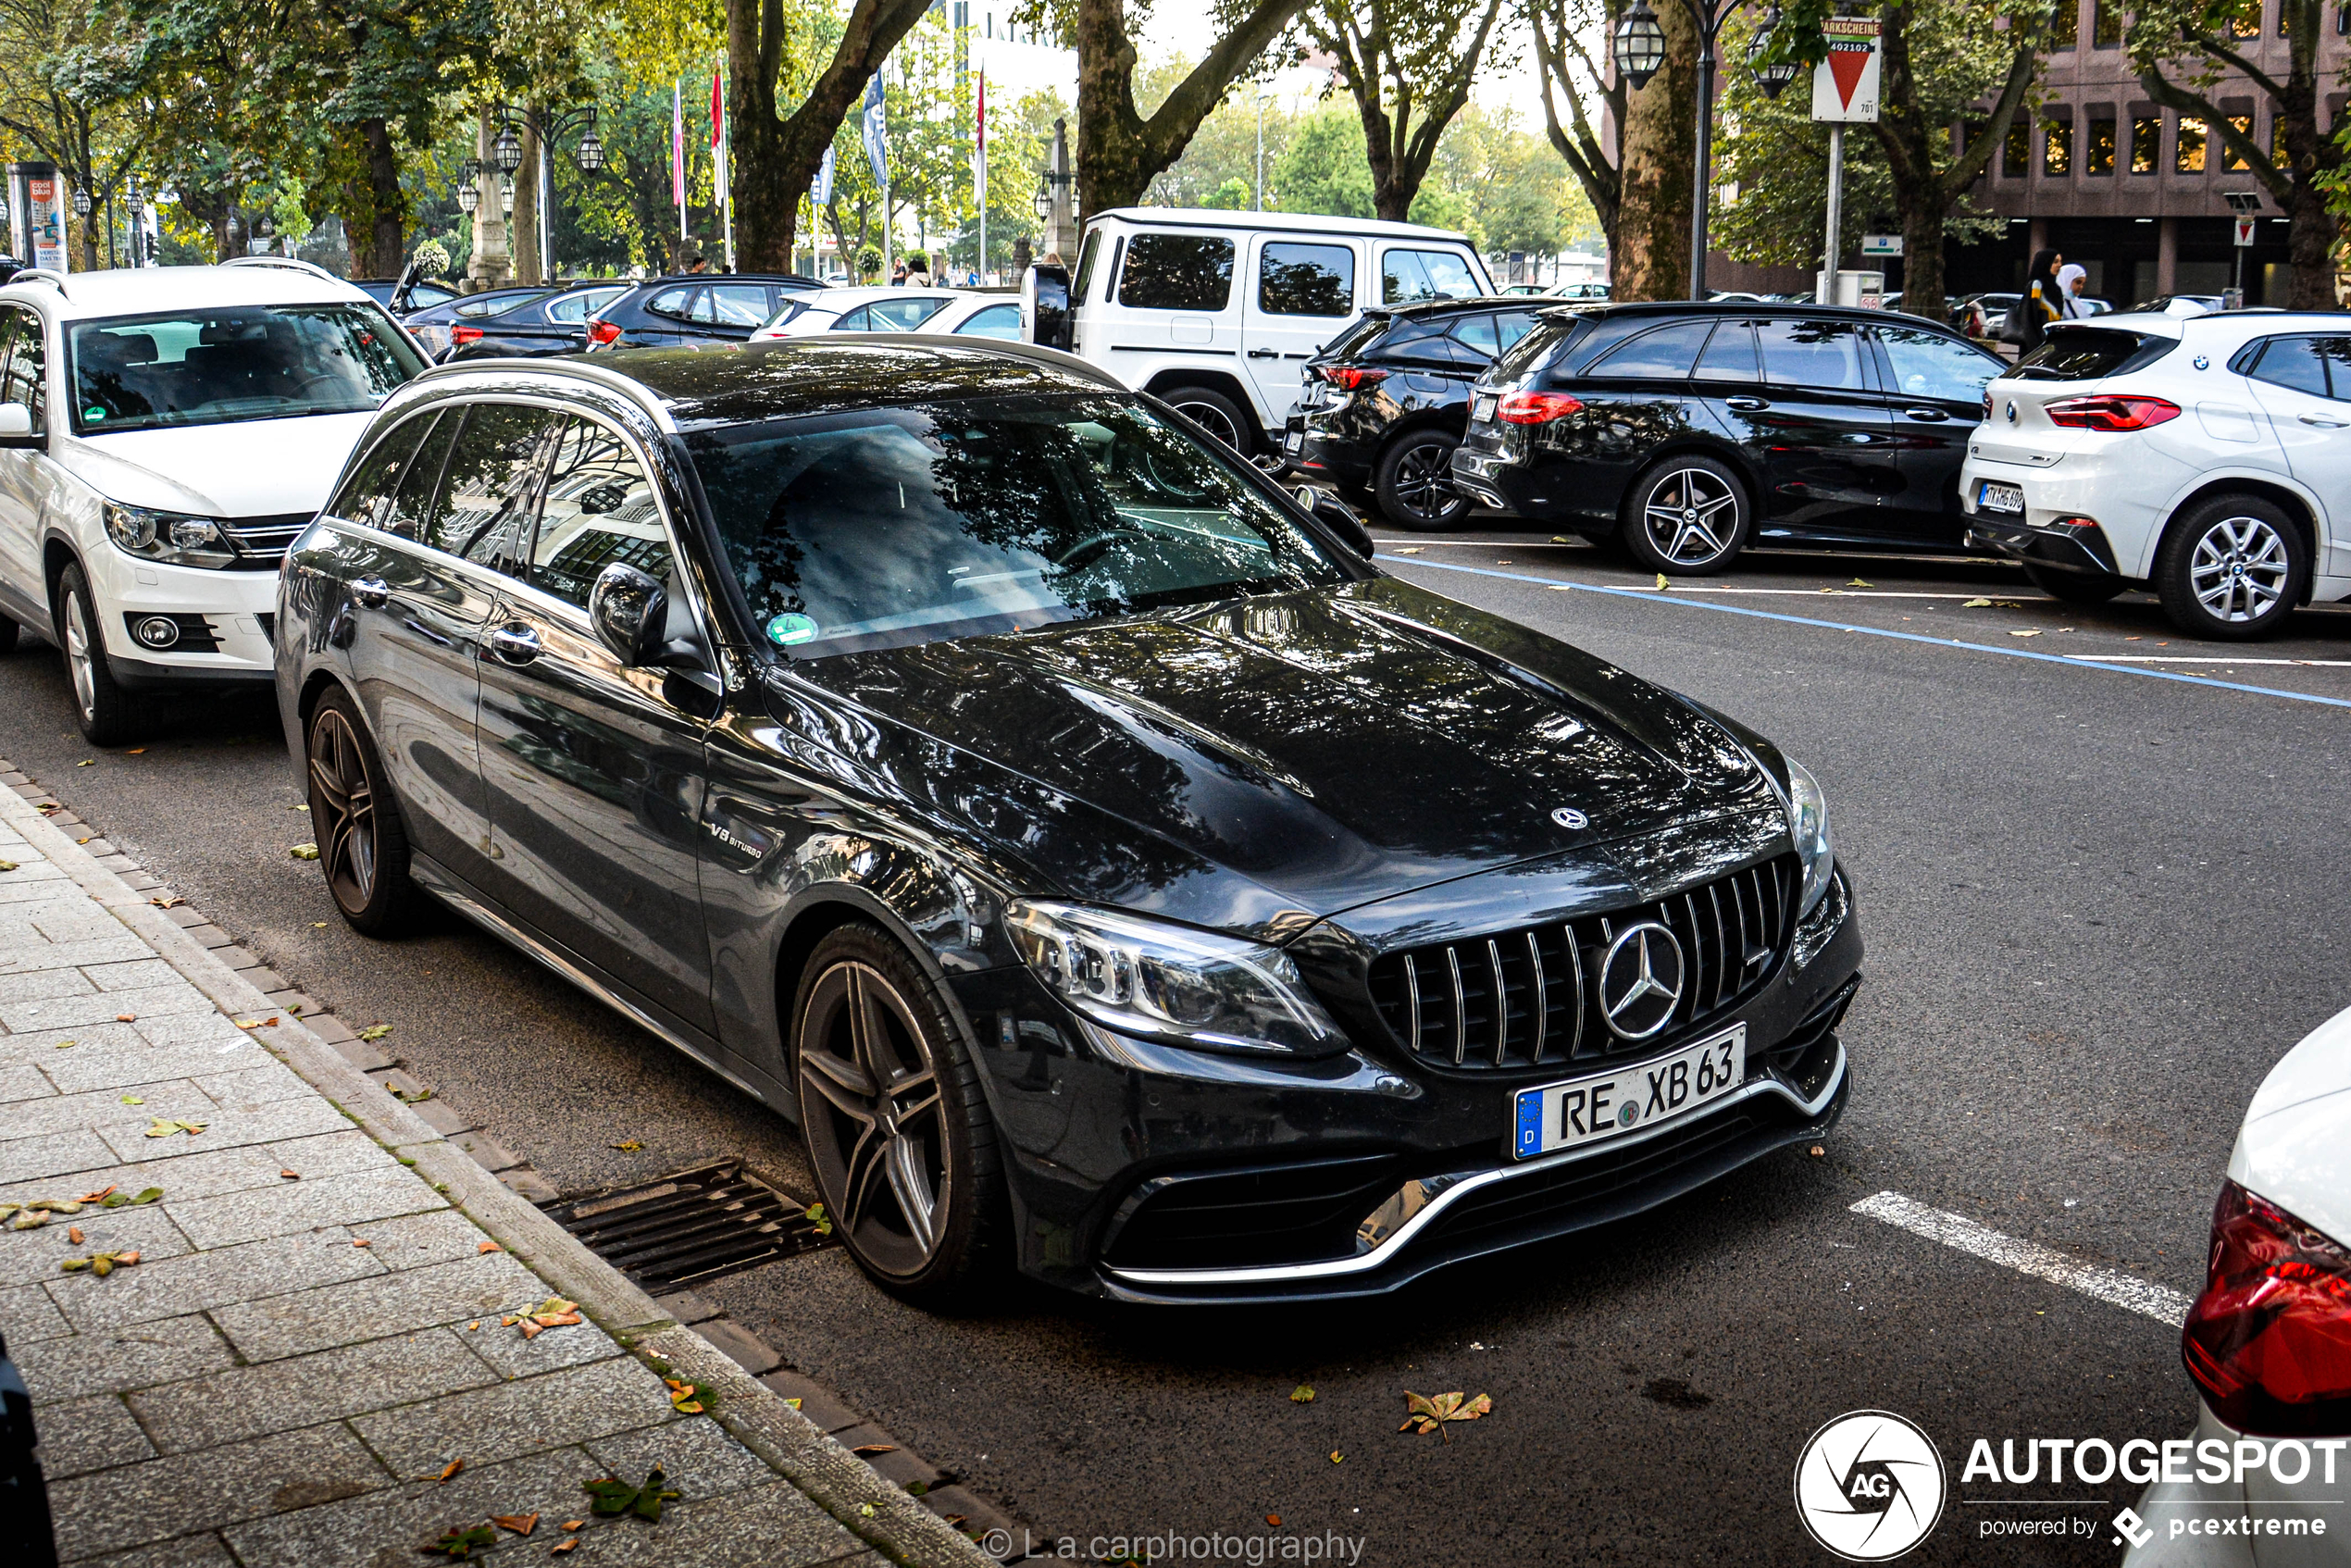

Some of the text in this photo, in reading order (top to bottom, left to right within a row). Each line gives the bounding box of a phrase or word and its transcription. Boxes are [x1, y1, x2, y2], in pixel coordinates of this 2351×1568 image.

[1831, 43, 1868, 52] 402102
[1861, 104, 1873, 113] 701
[786, 618, 797, 629] 4
[711, 823, 763, 859] V8 BITURBO
[1560, 1039, 1734, 1139] RE XB 63
[1524, 1130, 1535, 1144] D
